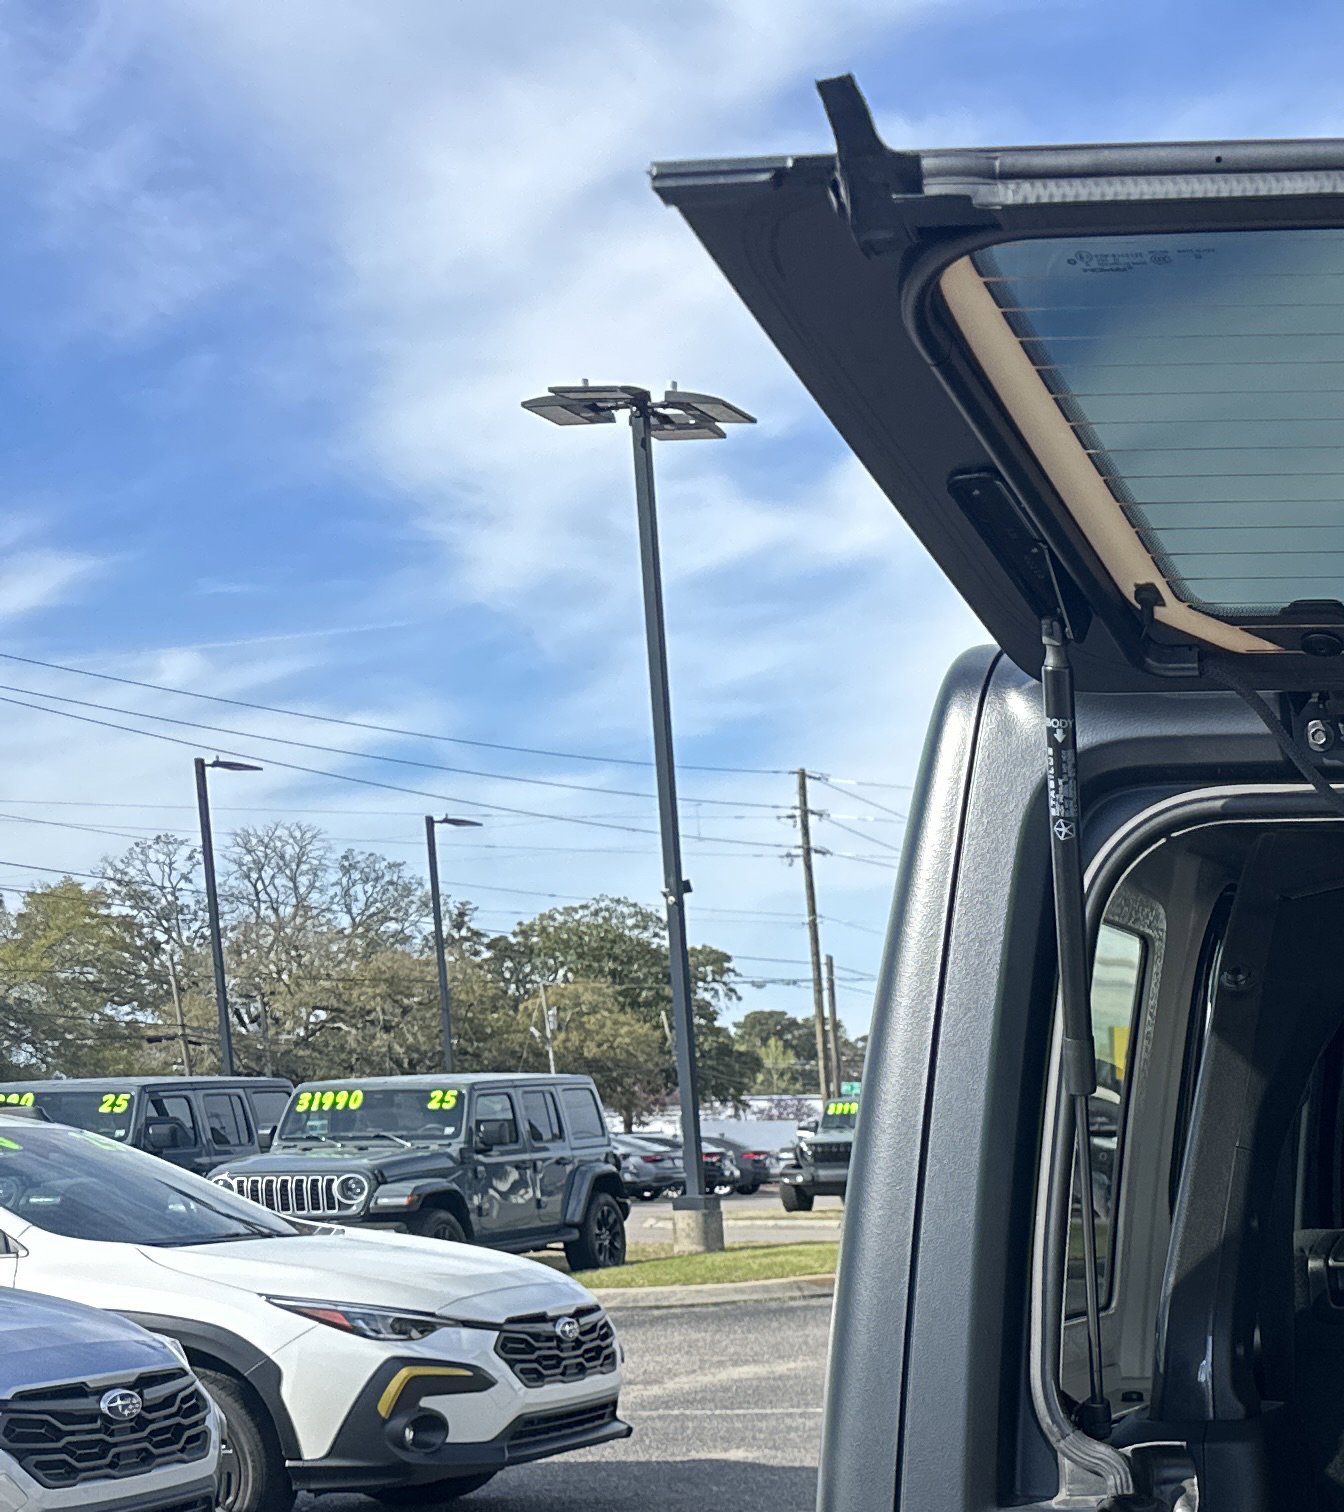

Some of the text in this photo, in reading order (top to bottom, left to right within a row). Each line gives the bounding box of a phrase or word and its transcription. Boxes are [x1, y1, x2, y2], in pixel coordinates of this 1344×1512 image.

[98, 1093, 131, 1113] 25
[295, 1089, 458, 1112] 31990 25
